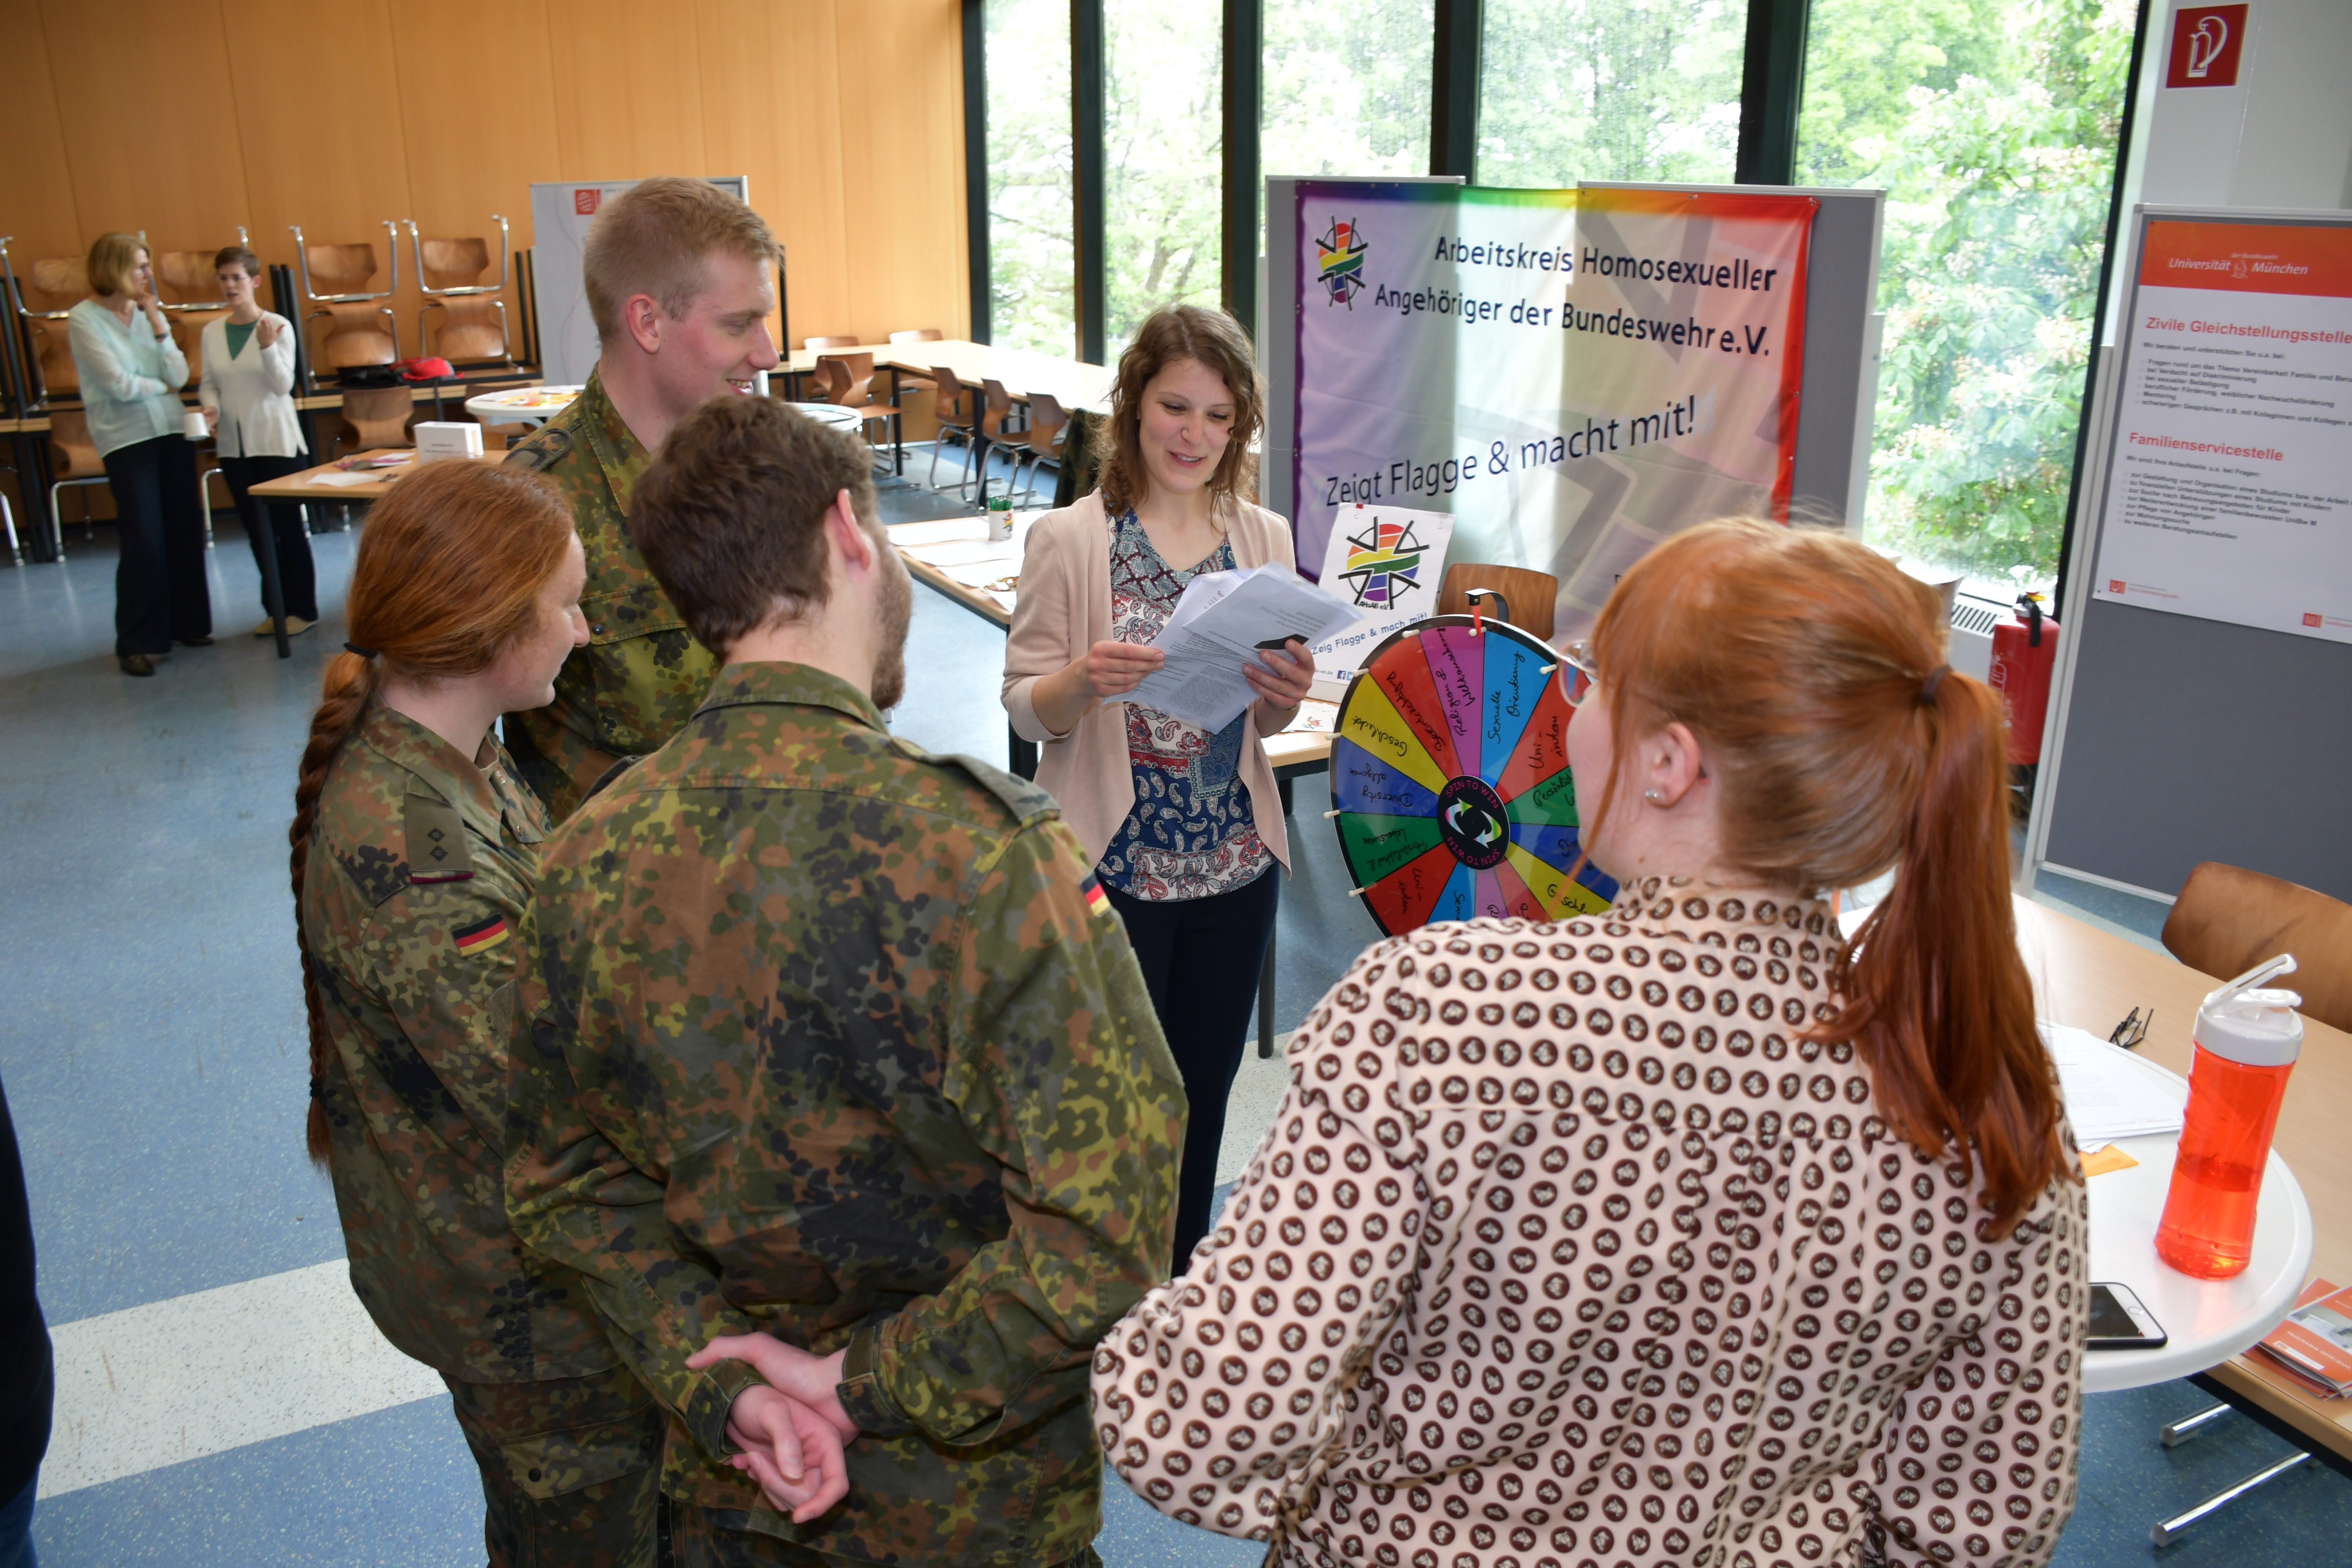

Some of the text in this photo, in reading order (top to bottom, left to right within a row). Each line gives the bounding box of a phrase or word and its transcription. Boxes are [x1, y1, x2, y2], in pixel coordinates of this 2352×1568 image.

[1435, 236, 1777, 291] Arbeitskreis Homosexueller
[2169, 257, 2308, 275] Universität München
[1375, 283, 1769, 357] Angehöriger der Bundeswehr e.V.
[2146, 317, 2352, 344] Zivile Gleichstellungsstelle
[2159, 368, 2188, 376] Verdacht
[2243, 367, 2288, 377] Vereinbarkeit
[2291, 371, 2317, 379] Familie
[1326, 395, 1696, 506] Zeigt Flagge & macht mit!
[2129, 432, 2284, 461] Familienservicestelle
[1311, 643, 1333, 656] Zeig
[1335, 632, 1367, 648] Flagge
[1370, 628, 1377, 637] &
[1381, 619, 1406, 634] mach
[1487, 690, 1501, 745] Sexuelle
[1361, 784, 1413, 808] Diversity
[1445, 780, 1500, 809] SPIN TO WIN
[1447, 836, 1500, 866] SPIN TO WIN
